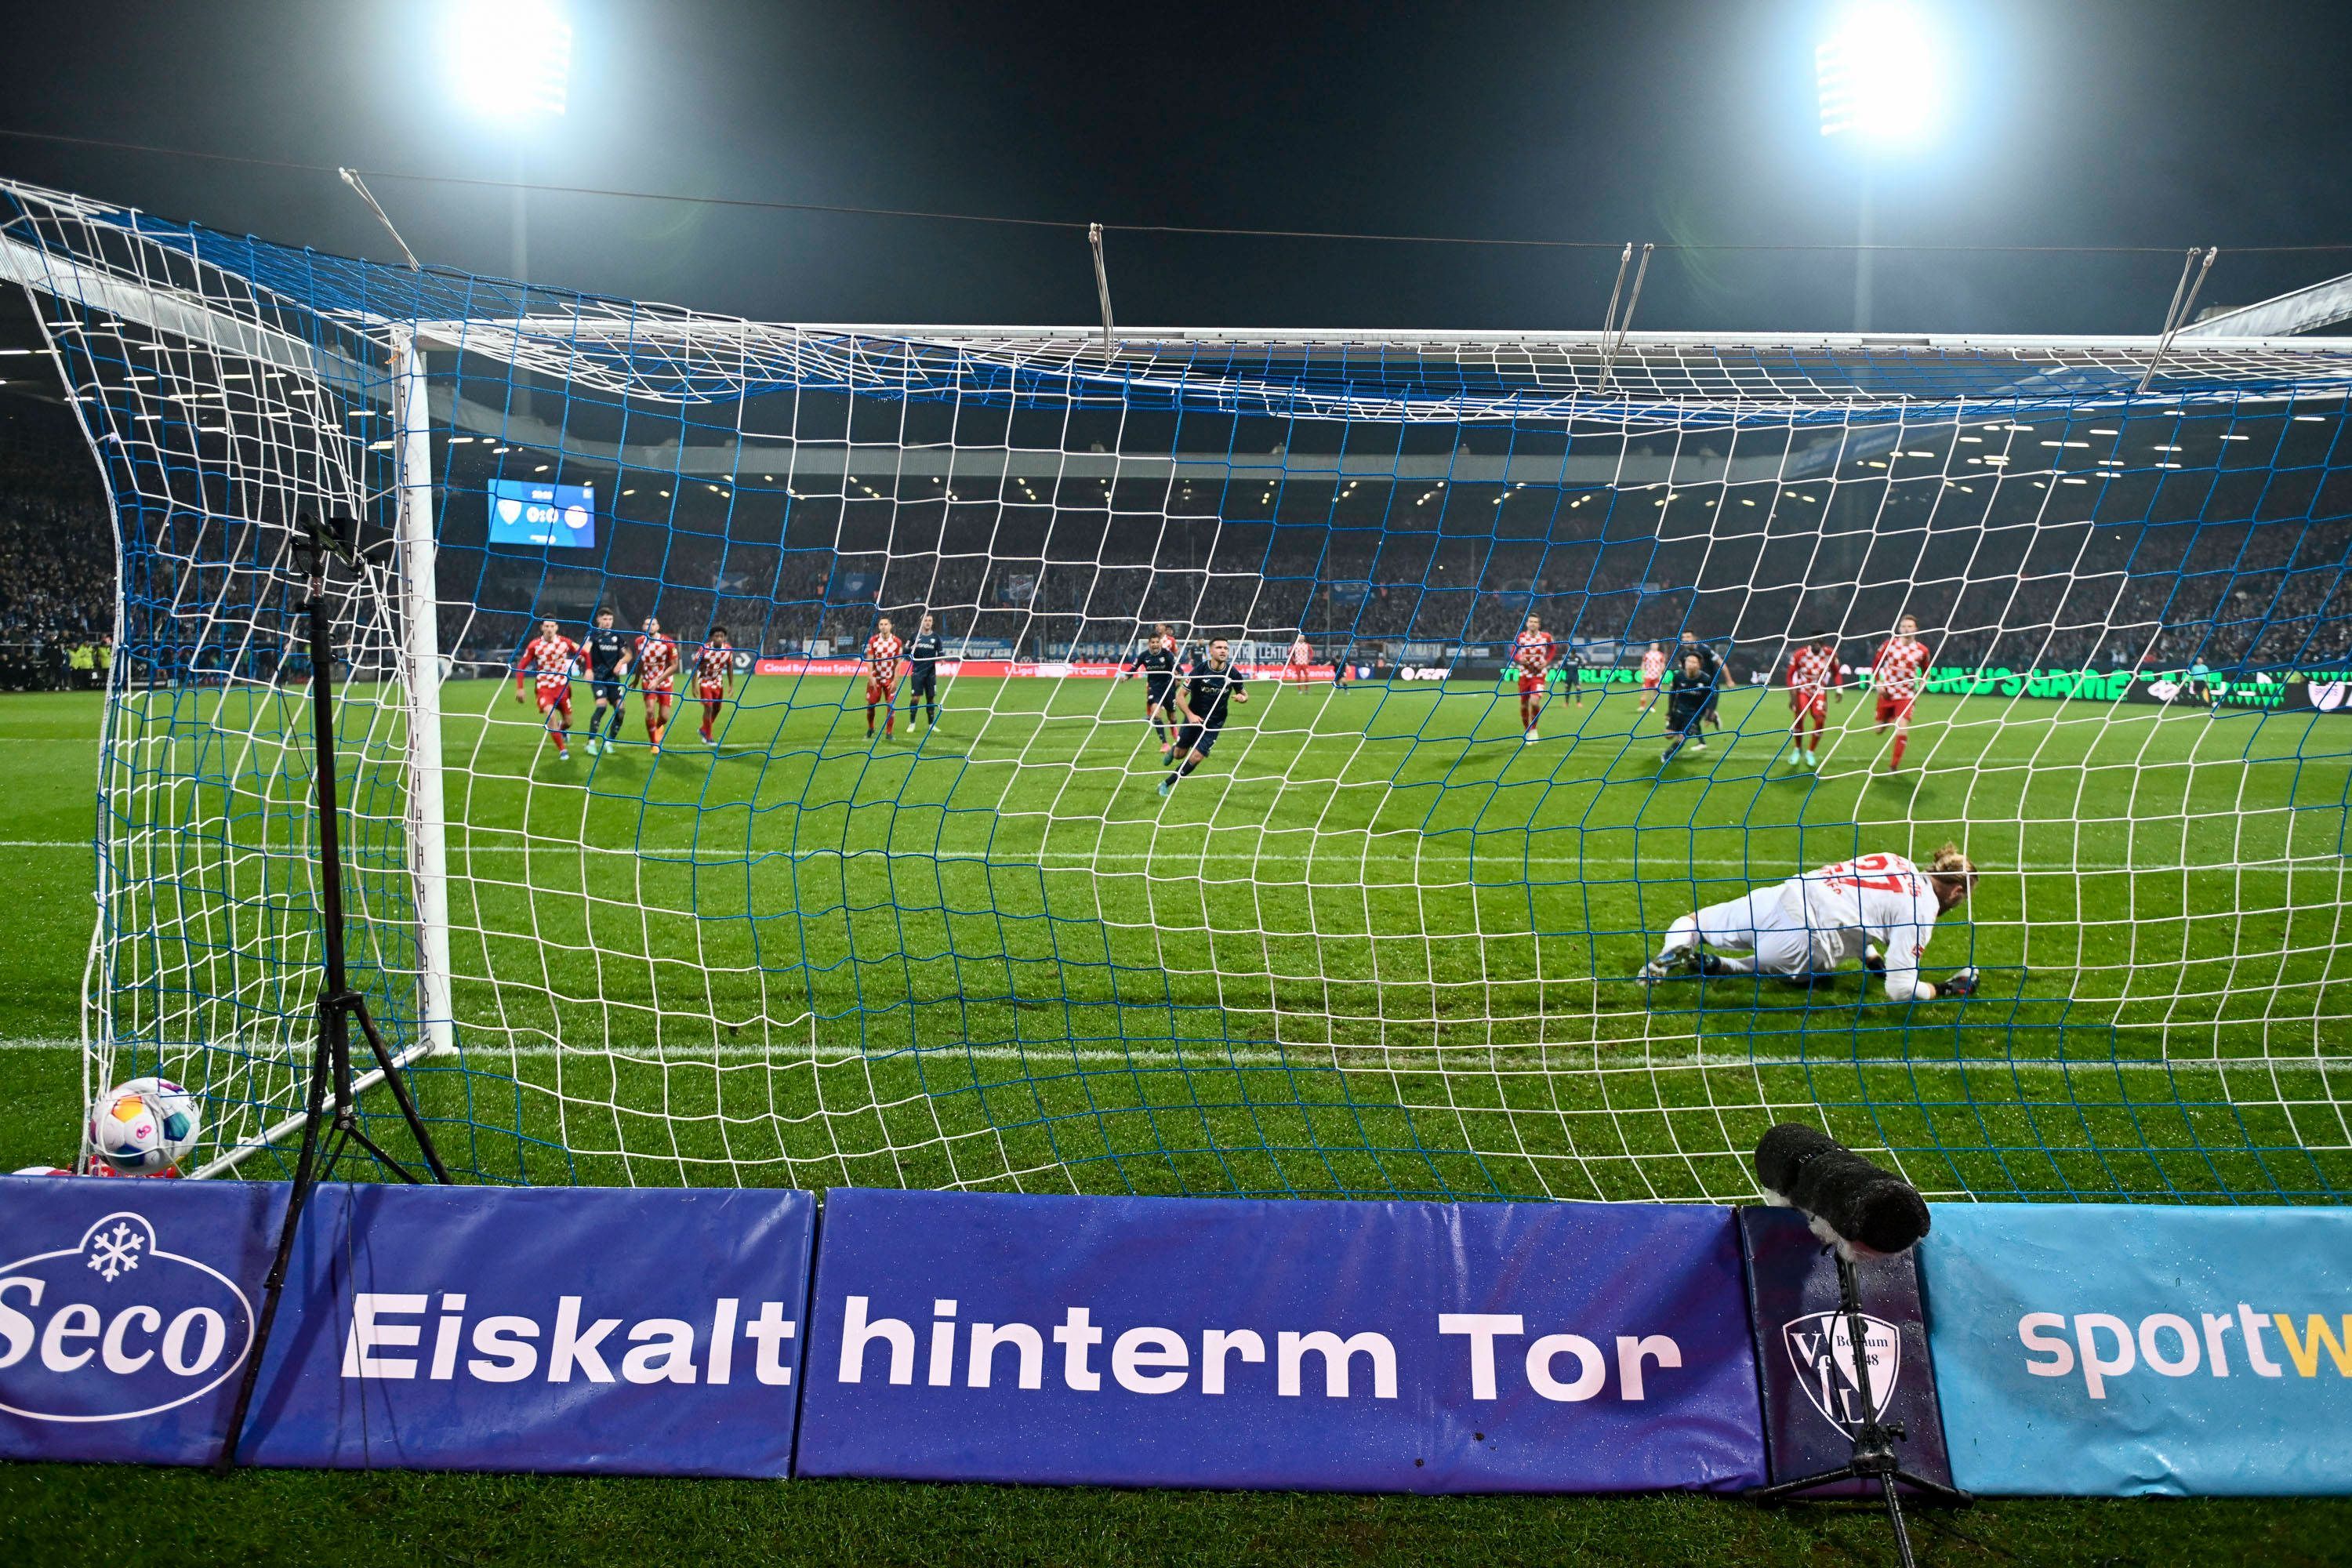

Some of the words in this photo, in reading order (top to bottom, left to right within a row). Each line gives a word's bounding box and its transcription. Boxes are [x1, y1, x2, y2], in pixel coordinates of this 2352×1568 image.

[764, 663, 792, 673] Cloud
[793, 664, 833, 674] Business
[1545, 668, 1634, 684] WRLD'S
[1833, 855, 1904, 894] 27
[0, 1276, 226, 1376] Seco
[341, 1293, 796, 1385] Eiskalt
[838, 1295, 1398, 1399] hinterm
[1439, 1313, 1682, 1402] Tor
[1836, 1334, 1889, 1348] Boum
[1851, 1354, 1879, 1367] 148
